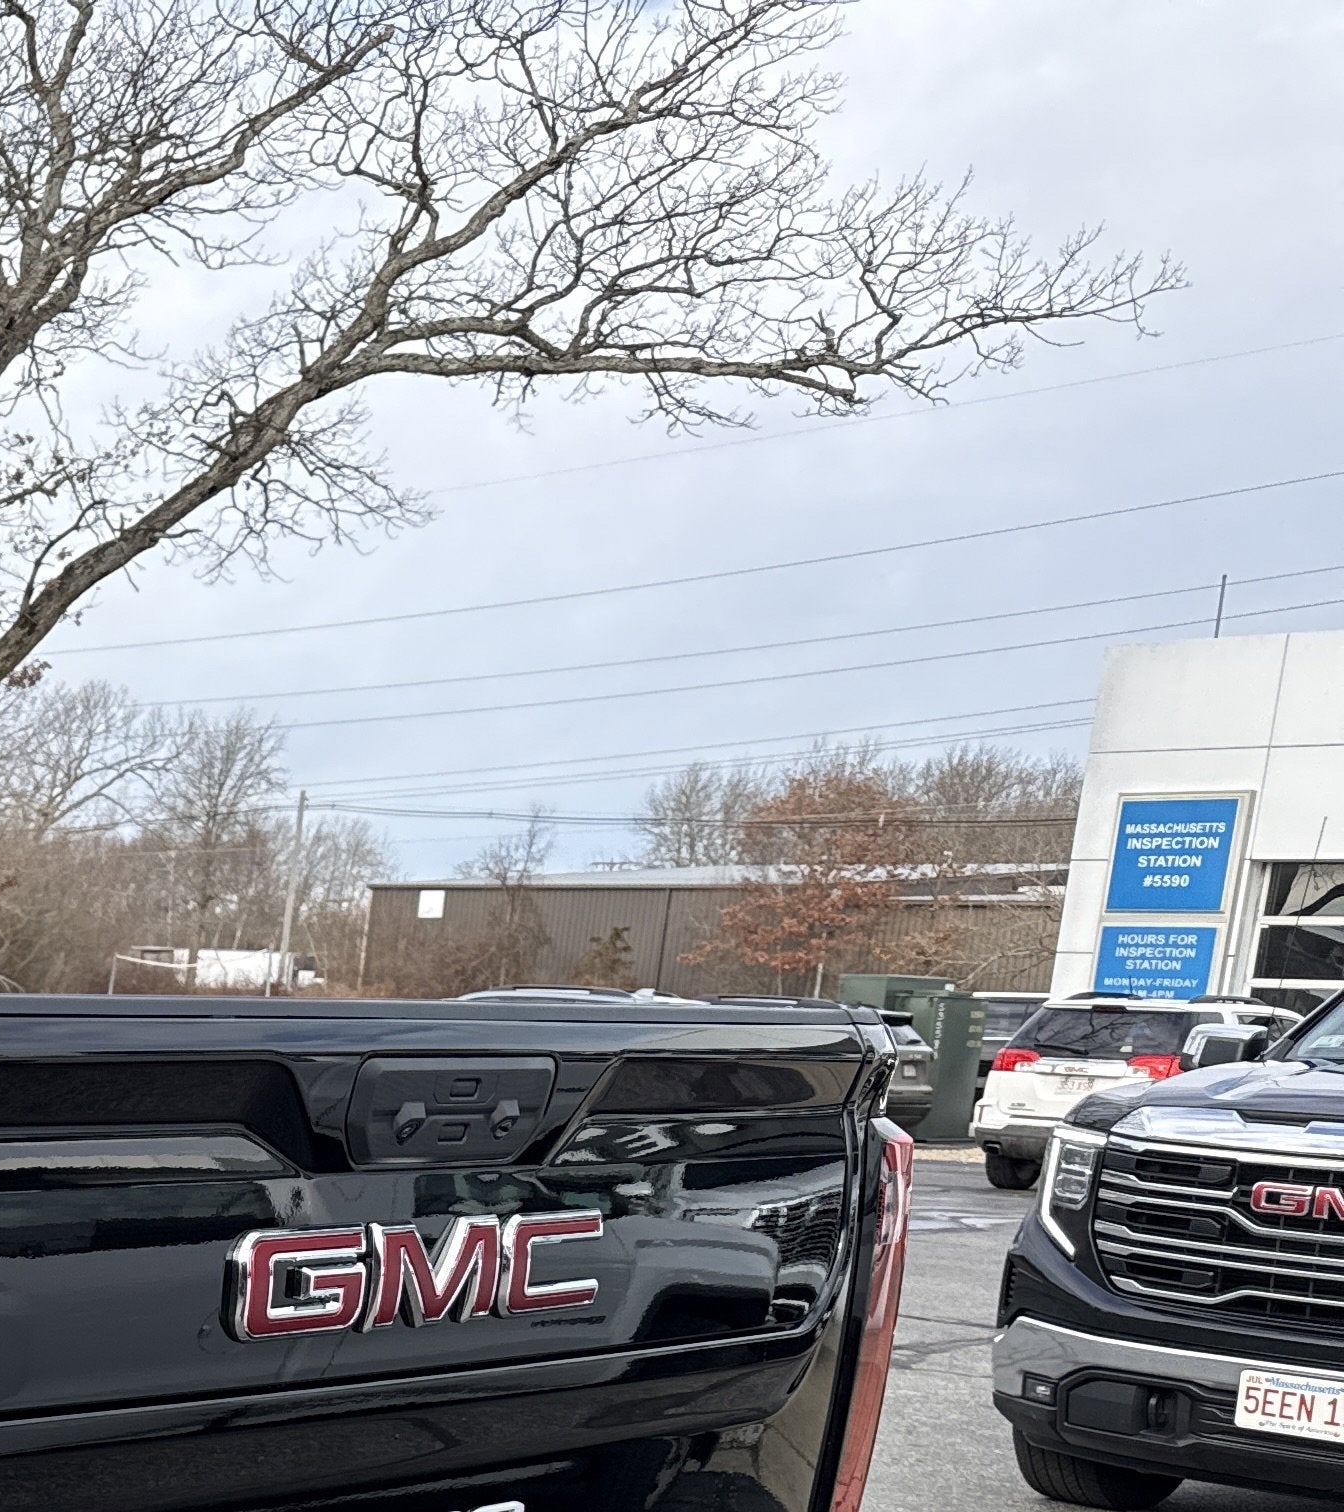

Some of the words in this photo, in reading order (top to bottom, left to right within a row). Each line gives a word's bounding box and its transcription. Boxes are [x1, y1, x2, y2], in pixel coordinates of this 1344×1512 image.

[1125, 822, 1226, 834] MASSACHUSETTS
[1127, 836, 1219, 849] INSPECTION
[1137, 855, 1202, 867] STATION
[1142, 874, 1190, 888] #5590
[1118, 934, 1165, 945] HOURS
[1168, 934, 1198, 945] FOR
[1115, 947, 1197, 958] INSPECTION
[1124, 959, 1182, 971] STATION
[1103, 977, 1199, 988] MONDAY-FRIDAY
[1249, 1181, 1344, 1221] GM
[219, 1208, 604, 1344] GMC
[1246, 1375, 1263, 1385] JUL
[1243, 1386, 1315, 1423] 5EEN
[1323, 1397, 1344, 1427] 1
